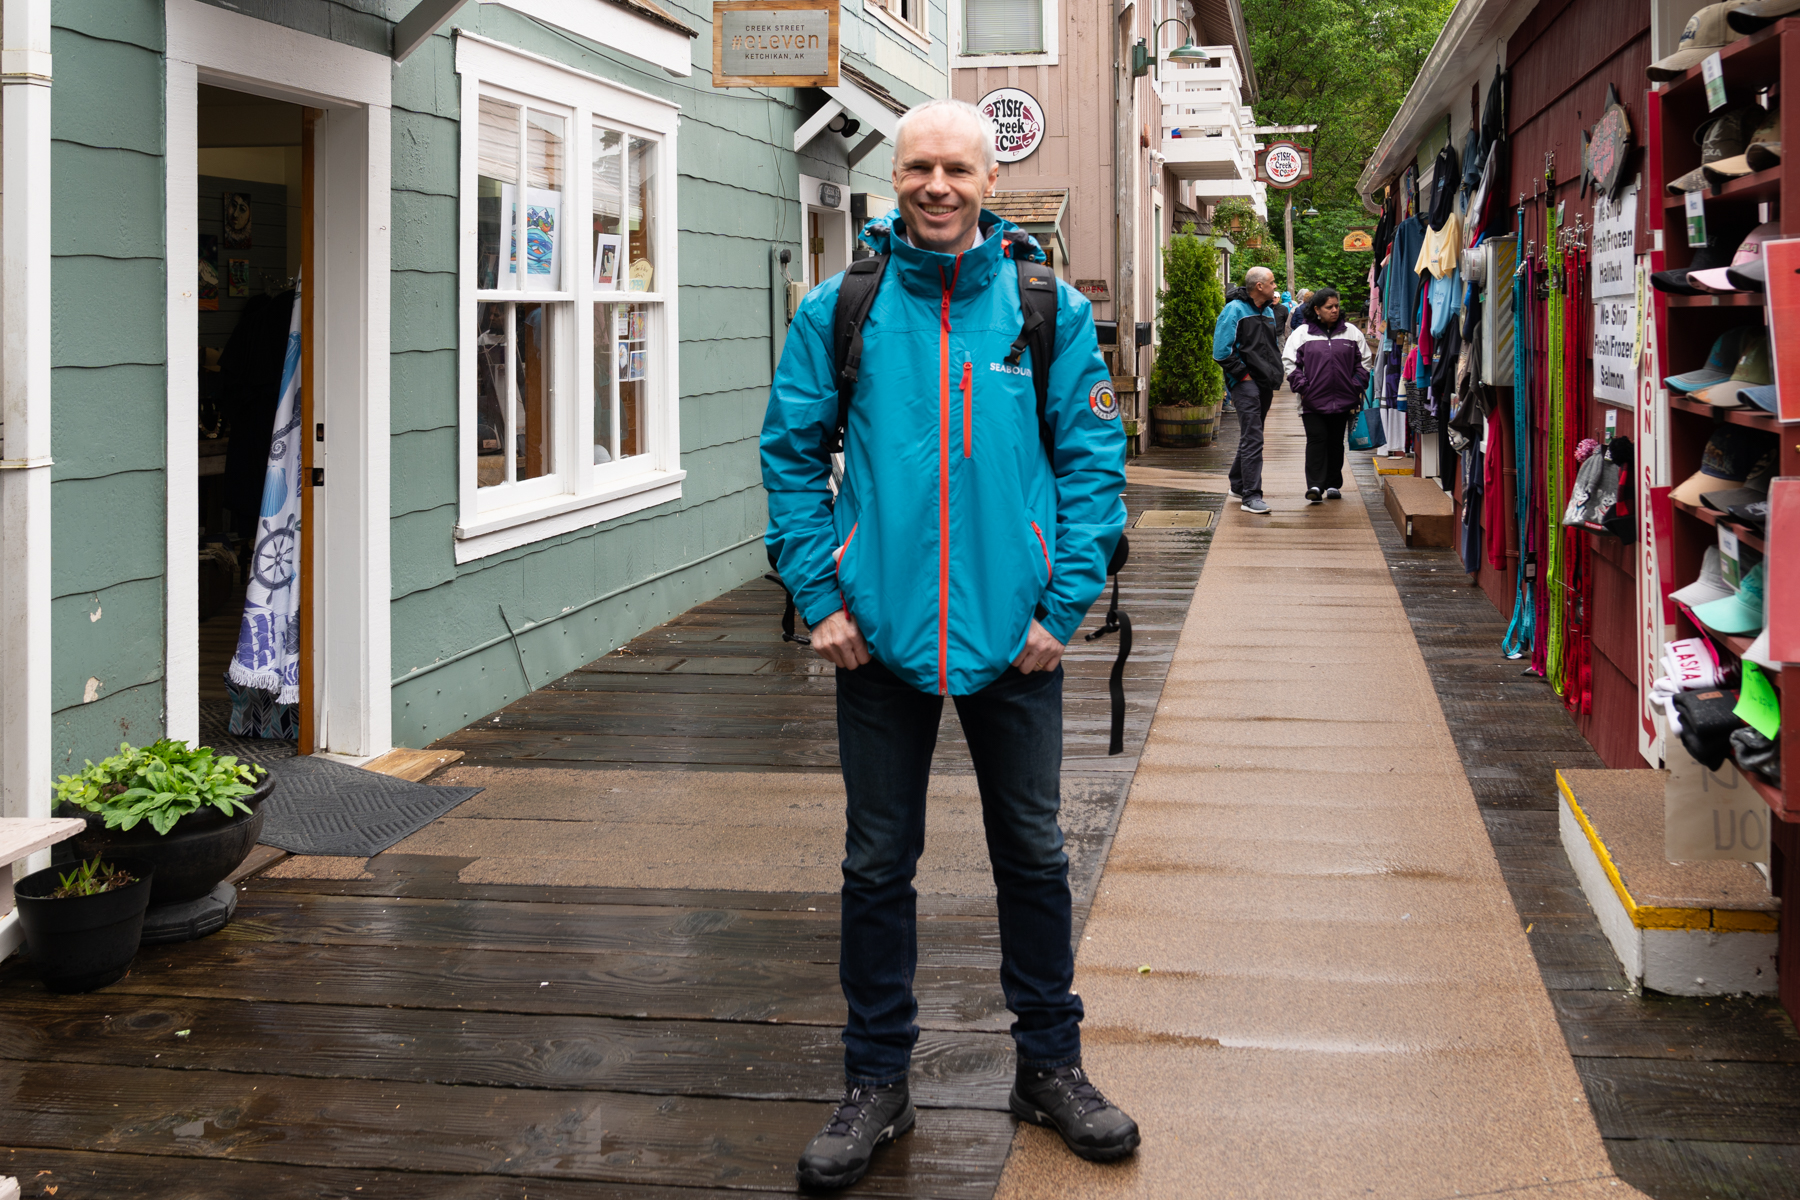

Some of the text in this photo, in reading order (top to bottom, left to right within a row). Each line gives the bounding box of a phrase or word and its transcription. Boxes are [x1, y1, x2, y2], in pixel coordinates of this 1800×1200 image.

[992, 98, 1023, 118] FISH
[1000, 135, 1018, 151] Co.
[1275, 161, 1292, 169] Creek
[1276, 152, 1291, 160] FISH
[1592, 229, 1632, 256] Fresh Frozen
[1599, 260, 1622, 284] Halibut
[1600, 304, 1628, 332] We Ship
[1594, 334, 1610, 356] Fresh
[1600, 364, 1625, 390] Salmon
